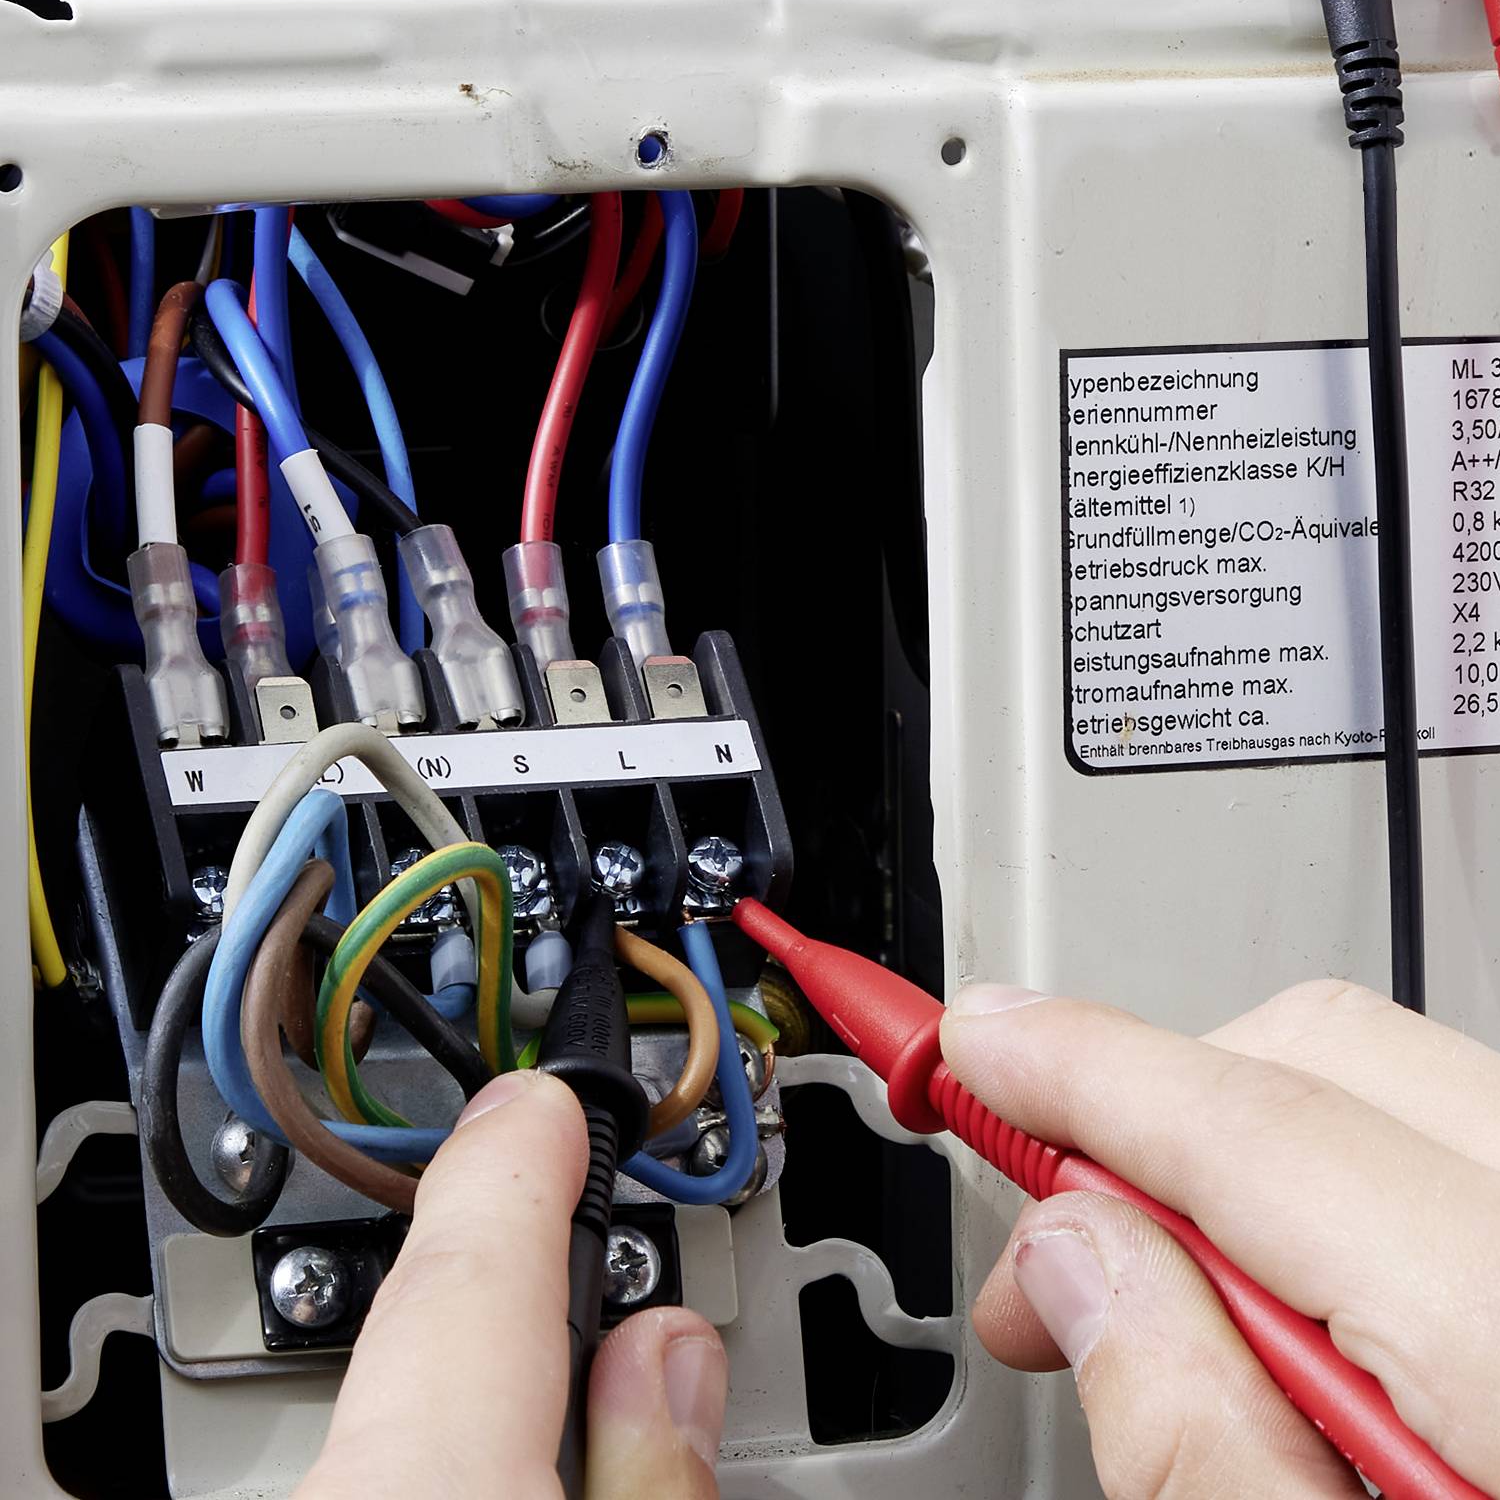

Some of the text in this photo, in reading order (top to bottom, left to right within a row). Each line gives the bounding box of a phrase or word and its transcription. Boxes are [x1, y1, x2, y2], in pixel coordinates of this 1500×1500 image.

[1452, 359, 1484, 380] ML
[1068, 369, 1260, 398] ypenbezeichnung
[1068, 427, 1358, 457] ennkühl-/Nennheizleistung
[1068, 456, 1345, 490] nergieeffizienzklasse K/H
[1453, 480, 1496, 502] R32
[1453, 511, 1484, 535] 0,8
[1070, 554, 1268, 580] etriebsdruck max.
[1453, 603, 1481, 623] X4
[1453, 633, 1486, 656] 2,2
[1073, 643, 1329, 674] eistungsaufnahme max.
[1454, 662, 1499, 686] 10,0
[1071, 676, 1294, 703] tromaufnahme max.
[1453, 693, 1499, 717] 26,5
[1071, 705, 1270, 735] etriebsgewicht ca.
[1128, 740, 1202, 756] brennbares
[1206, 736, 1295, 751] Treibhausgas
[1299, 732, 1331, 747] nach
[185, 768, 204, 793] W
[417, 755, 452, 780] (N)
[514, 754, 530, 775] S
[619, 750, 635, 772] L
[716, 742, 734, 766] N
